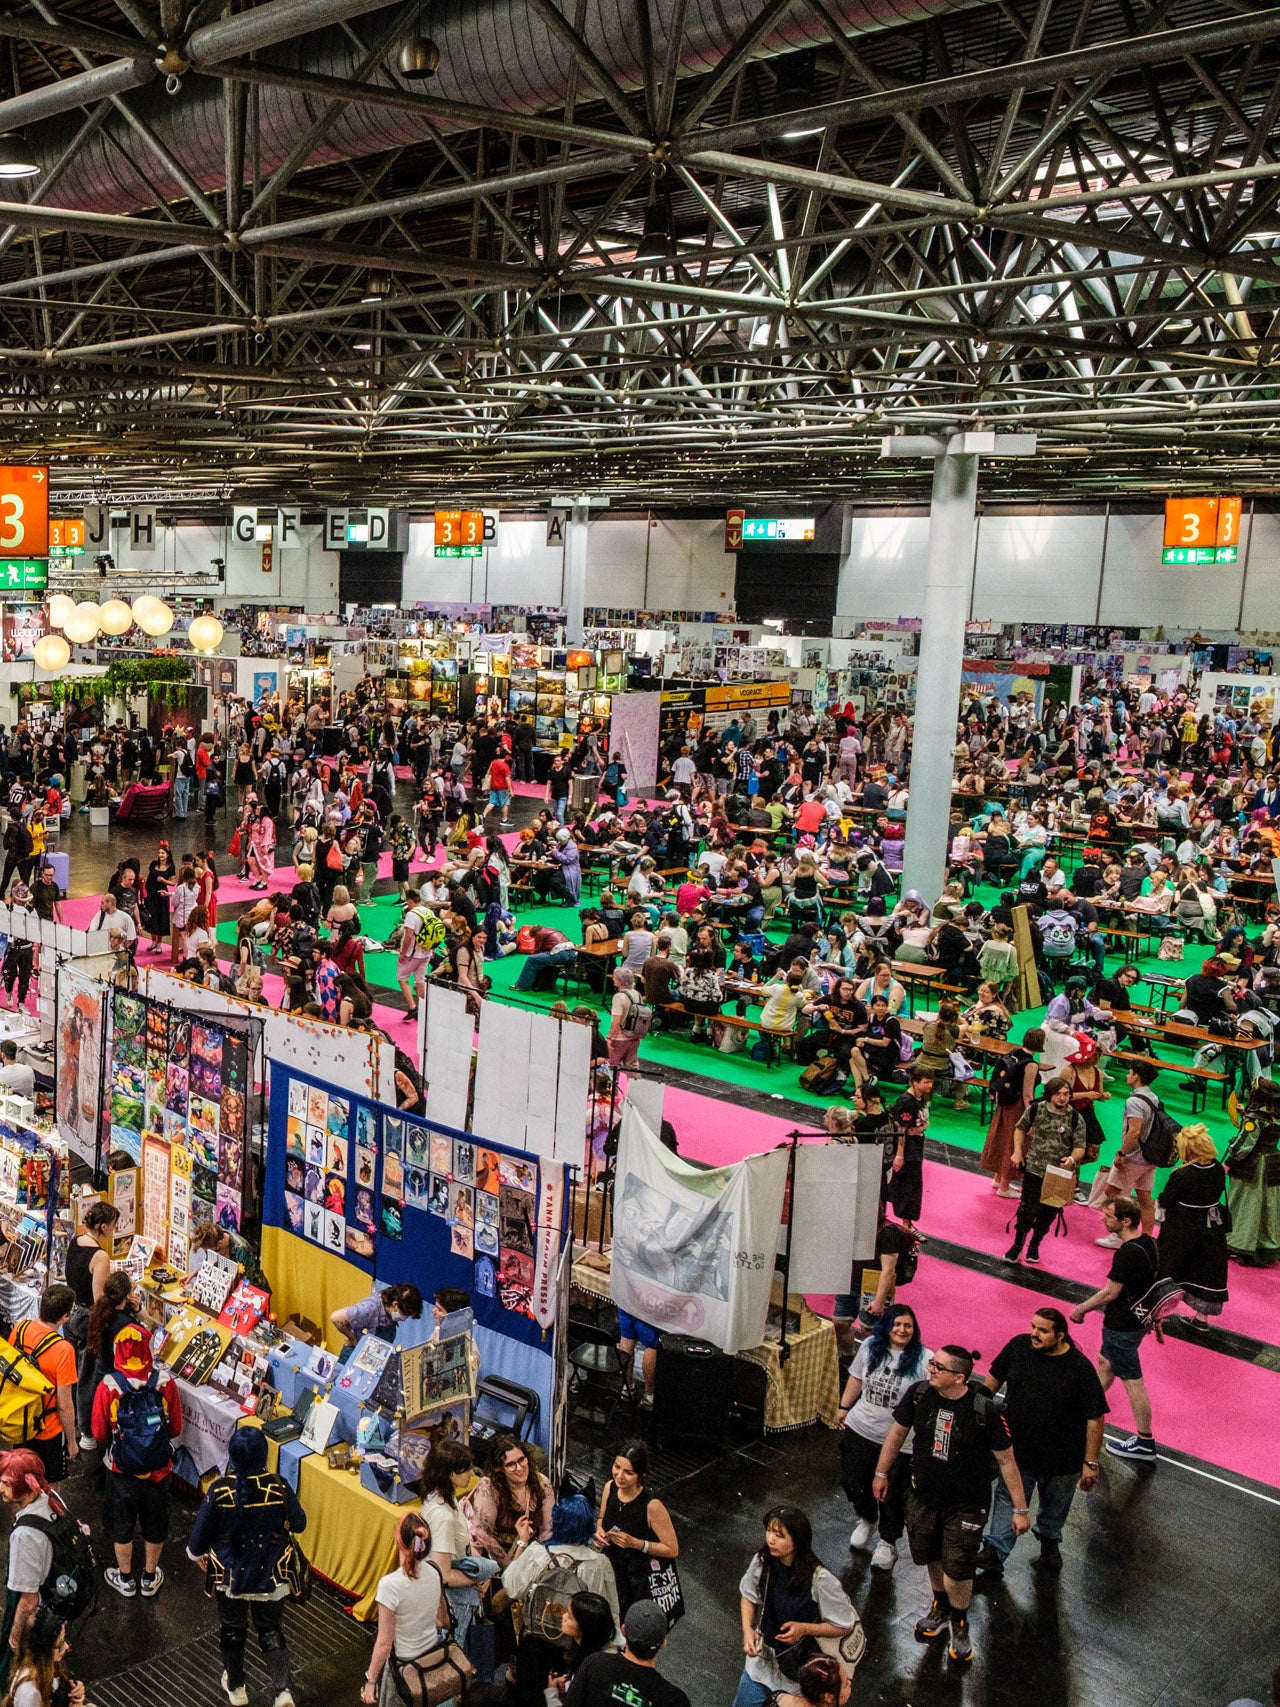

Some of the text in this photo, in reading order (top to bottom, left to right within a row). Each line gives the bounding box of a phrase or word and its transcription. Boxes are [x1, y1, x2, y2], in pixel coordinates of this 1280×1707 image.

[0, 493, 25, 548] 3
[89, 514, 105, 543] J
[134, 514, 152, 543] H
[236, 514, 254, 542] G
[282, 514, 296, 542] F
[330, 514, 345, 542] E
[370, 515, 386, 542] D
[442, 522, 452, 543] 3
[467, 521, 476, 542] 3
[483, 515, 496, 540] B
[548, 516, 562, 540] A
[1181, 513, 1200, 543] 3
[1223, 512, 1233, 542] 3
[53, 528, 59, 545] 3
[70, 528, 79, 544] 3
[10, 628, 45, 638] wacom
[540, 1273, 548, 1304] PRESS
